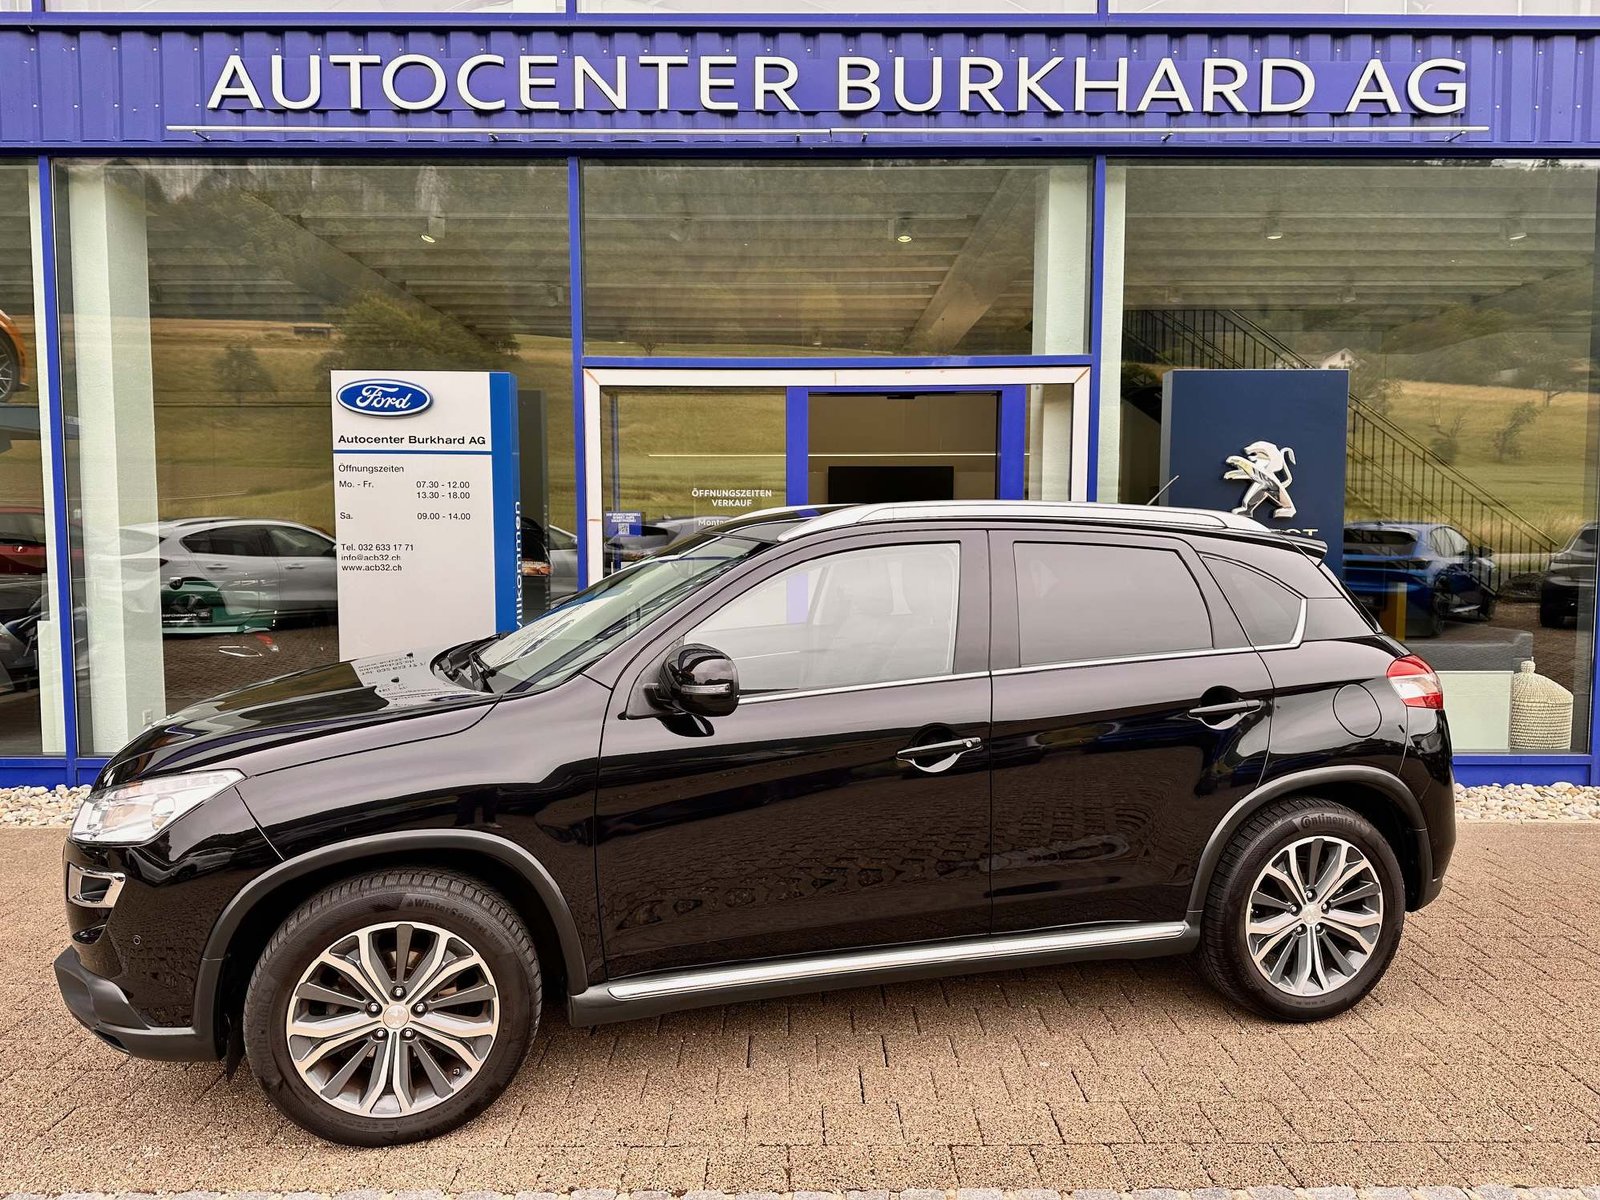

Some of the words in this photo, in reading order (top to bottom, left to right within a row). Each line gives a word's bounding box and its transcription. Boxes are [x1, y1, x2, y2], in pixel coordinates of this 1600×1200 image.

[207, 54, 801, 111] AUTOCENTER
[837, 56, 1316, 113] BURKHARD
[1345, 58, 1467, 115] AG
[356, 385, 412, 409] Ford
[338, 435, 405, 444] Autocenter
[408, 435, 465, 445] Burkhard
[468, 436, 486, 445] AG
[338, 463, 405, 474] Öffnungszeiten
[338, 480, 355, 488] Mo.
[362, 480, 375, 488] Fr.
[416, 481, 439, 489] 07.30
[447, 481, 470, 489] 12.00
[691, 487, 772, 497] ÖFFNUNGSZEITEN
[711, 499, 753, 507] VERKAUF
[339, 512, 354, 520] Sa.
[417, 512, 440, 520] 09.00
[448, 512, 471, 520] 14.00
[341, 543, 356, 551] Tel.
[358, 543, 374, 551] 032
[375, 543, 391, 551] 633
[341, 553, 402, 561] info@acb32.ch
[341, 563, 403, 572] www.acb32.ch
[515, 501, 523, 628] illkommen
